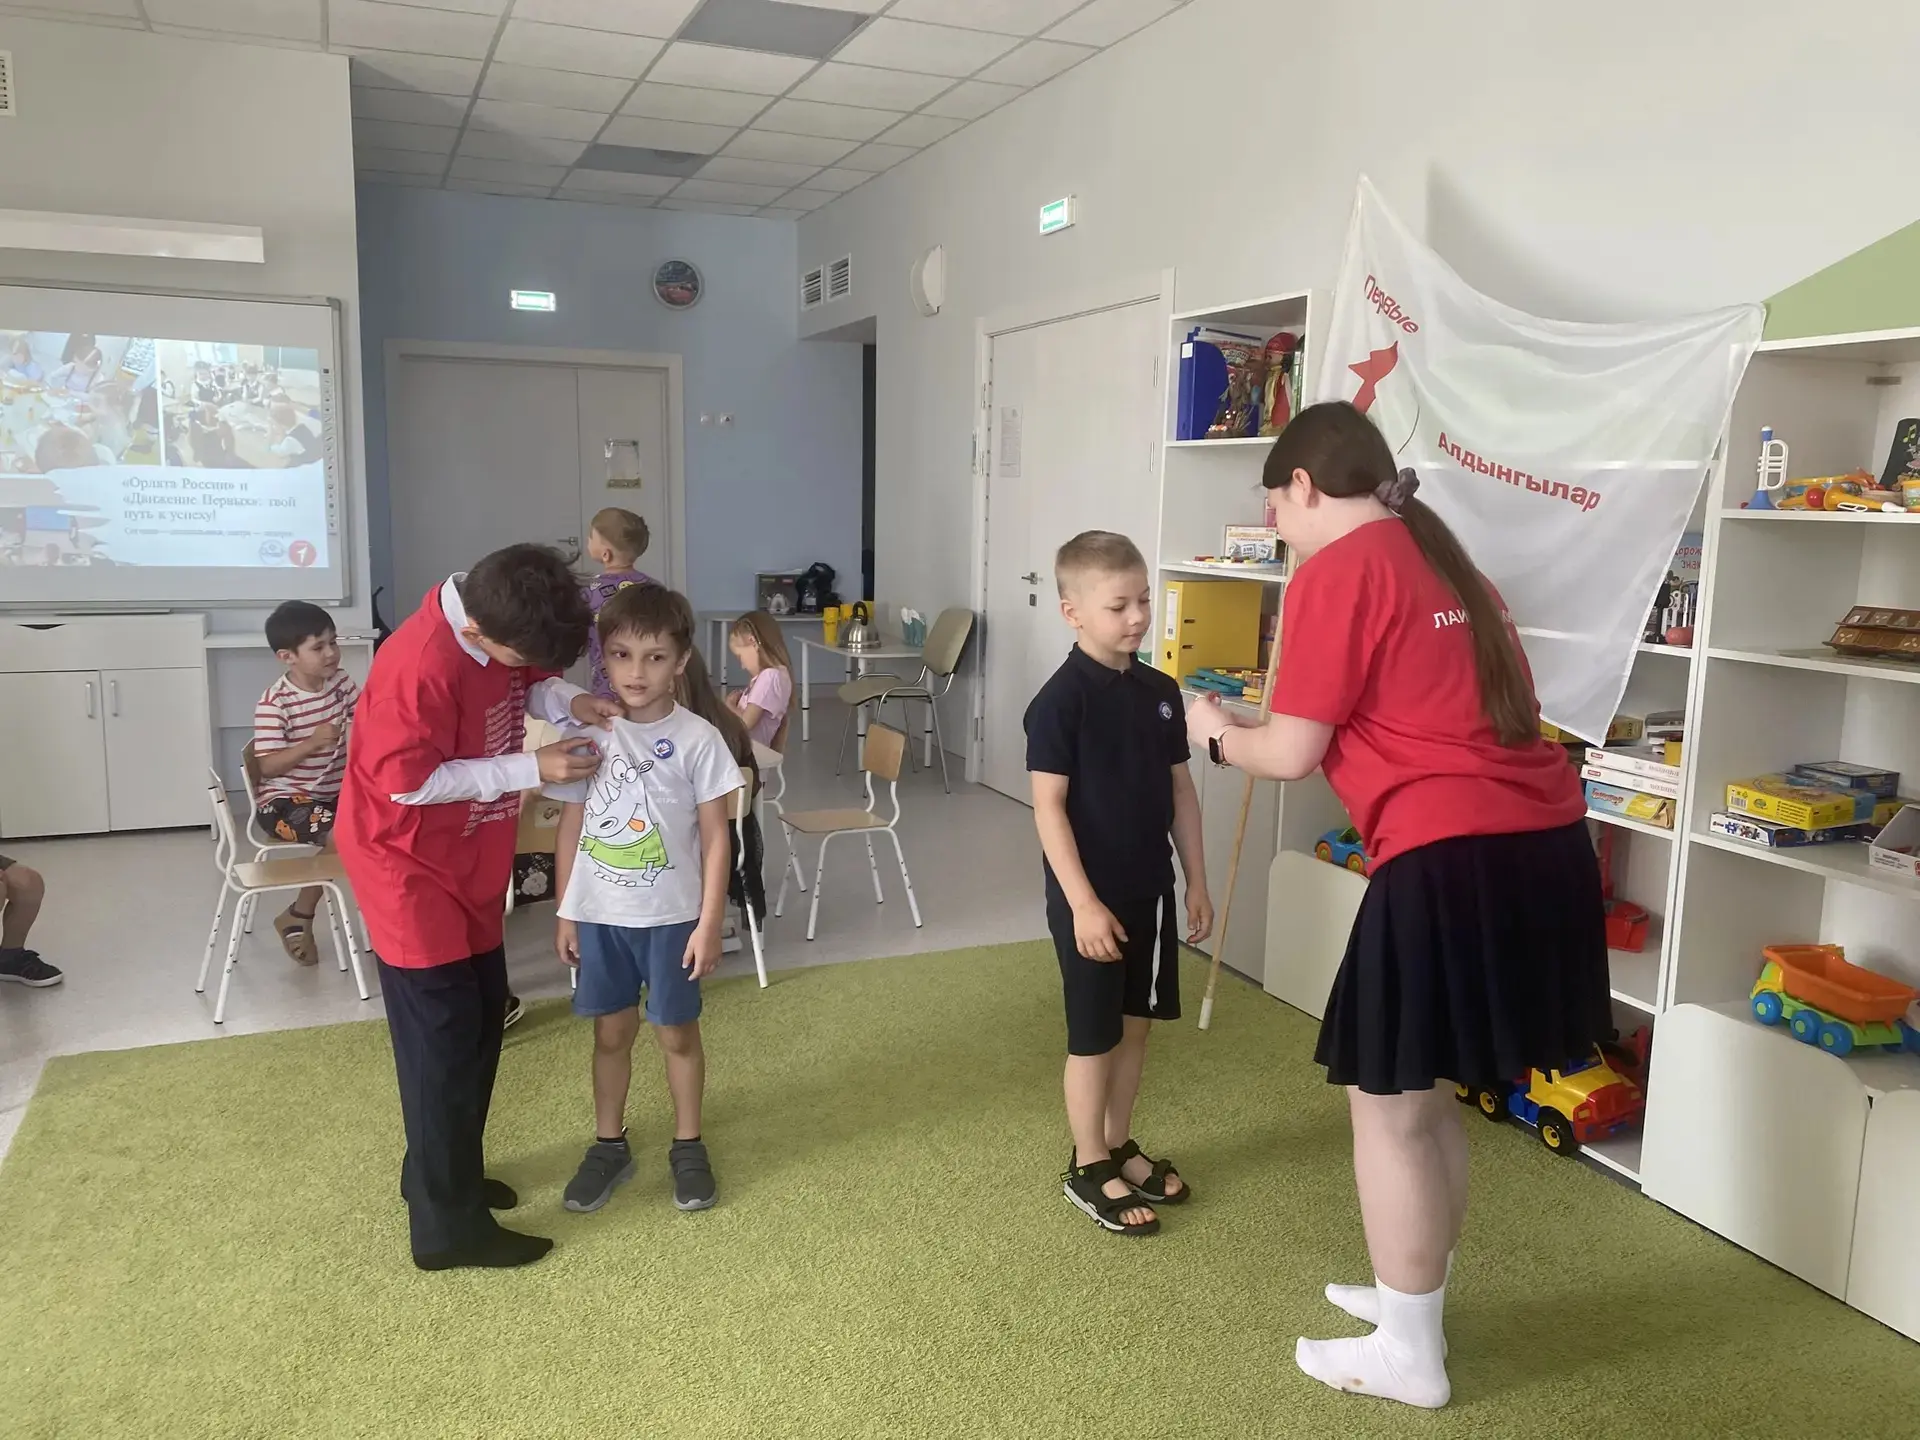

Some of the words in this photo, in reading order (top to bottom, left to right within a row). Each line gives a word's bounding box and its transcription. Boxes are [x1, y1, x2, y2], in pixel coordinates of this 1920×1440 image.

[1364, 274, 1419, 334] Первые
[1438, 432, 1601, 513] Алдынгылар
[124, 509, 154, 521] путь
[158, 511, 167, 519] к
